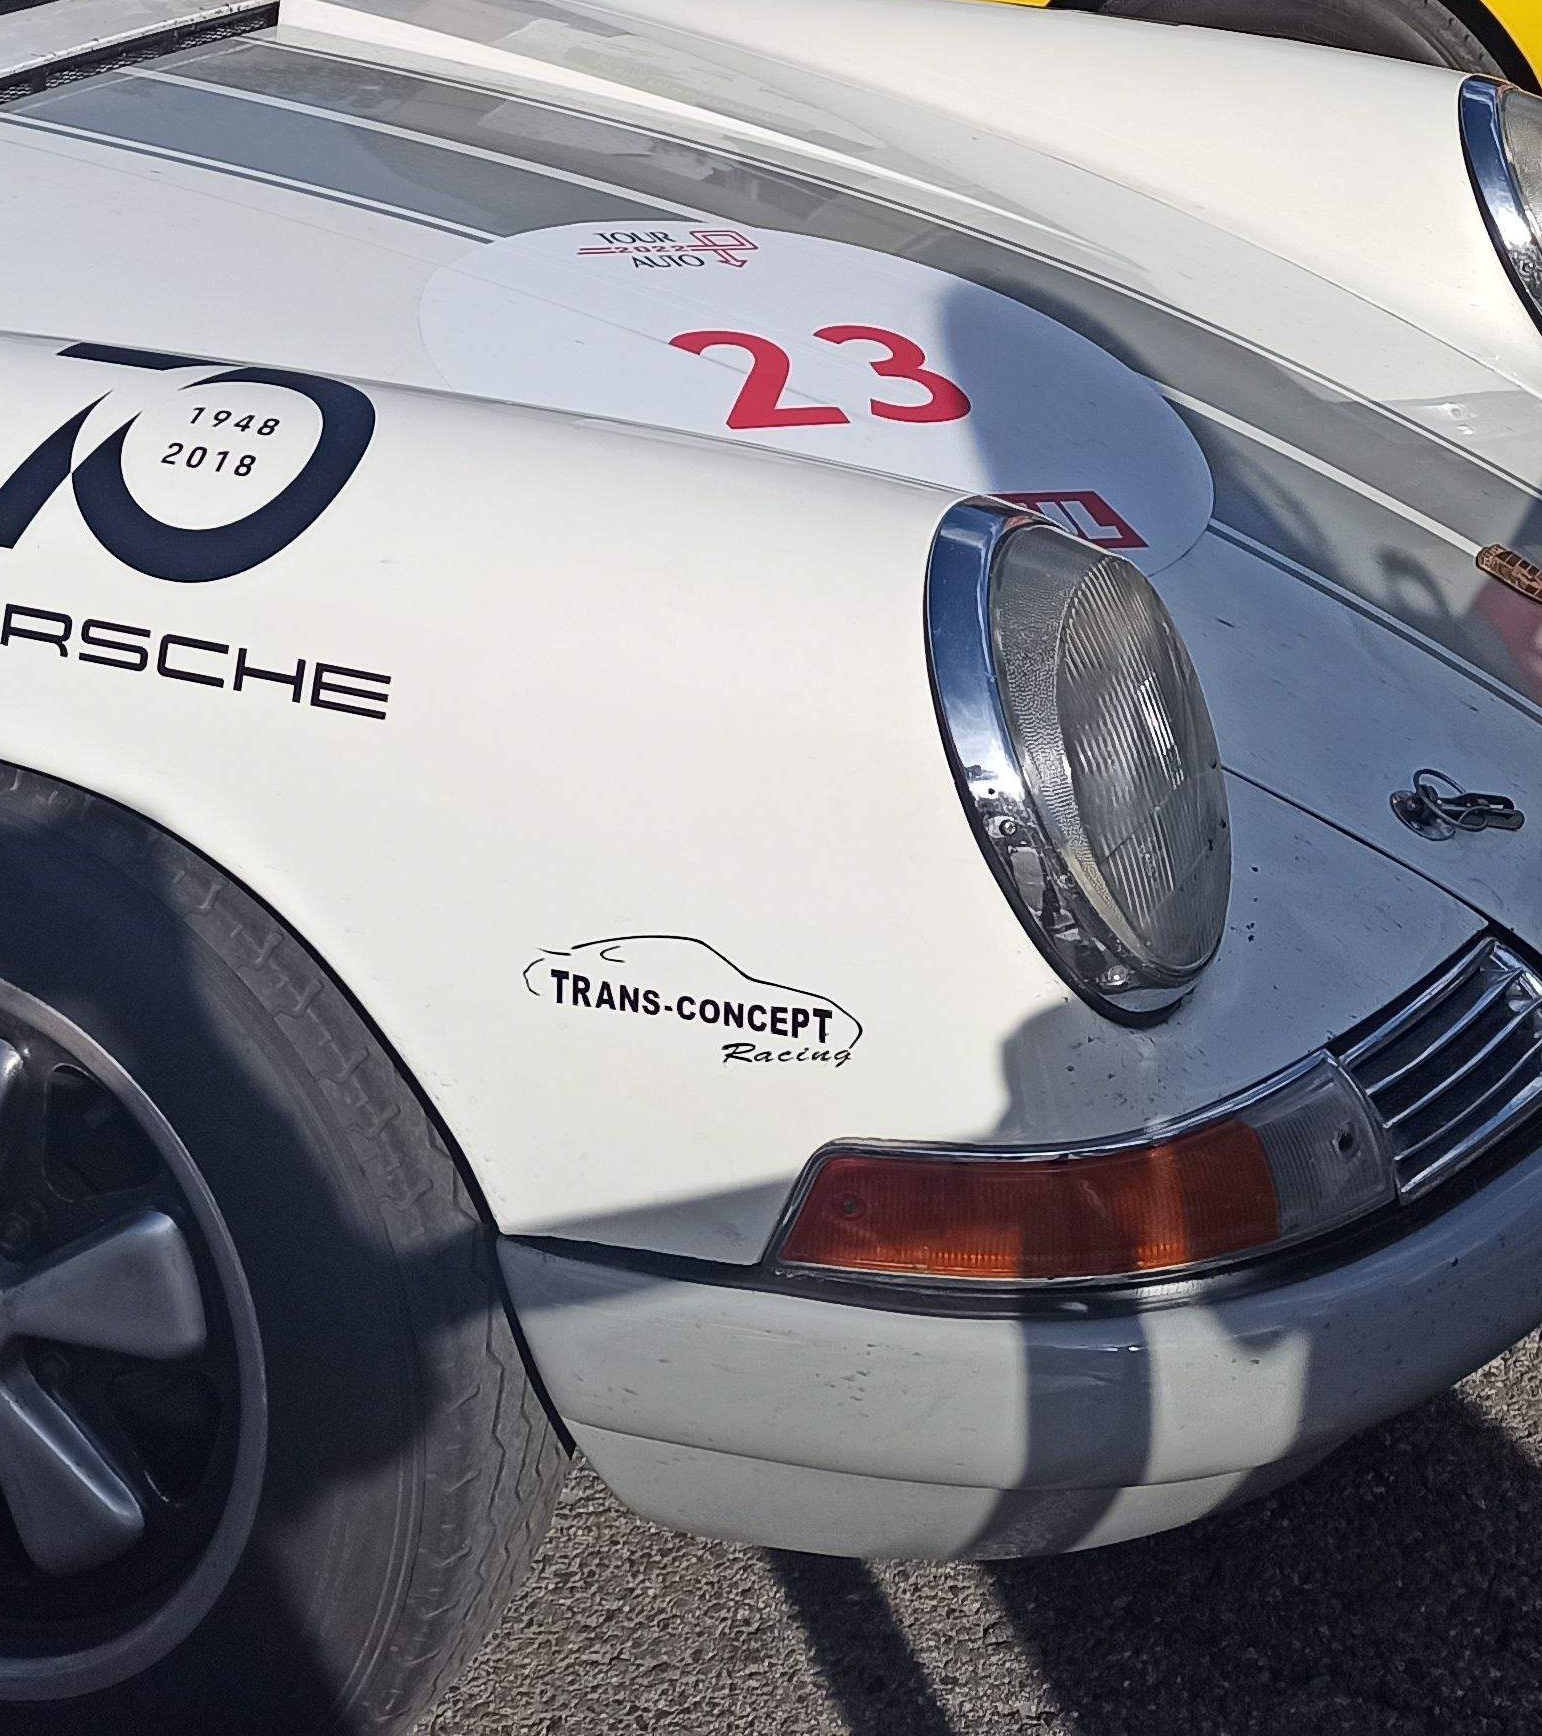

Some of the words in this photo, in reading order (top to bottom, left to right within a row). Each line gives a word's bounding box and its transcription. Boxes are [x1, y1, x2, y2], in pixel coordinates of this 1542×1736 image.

[592, 230, 678, 245] TOUR
[614, 245, 689, 255] 2022
[631, 253, 706, 269] AUTO
[668, 324, 972, 431] 23
[189, 406, 282, 437] 1948
[161, 442, 258, 478] 2018
[550, 968, 833, 1044] TRANS-CONCEPT
[721, 1042, 853, 1069] Racing
